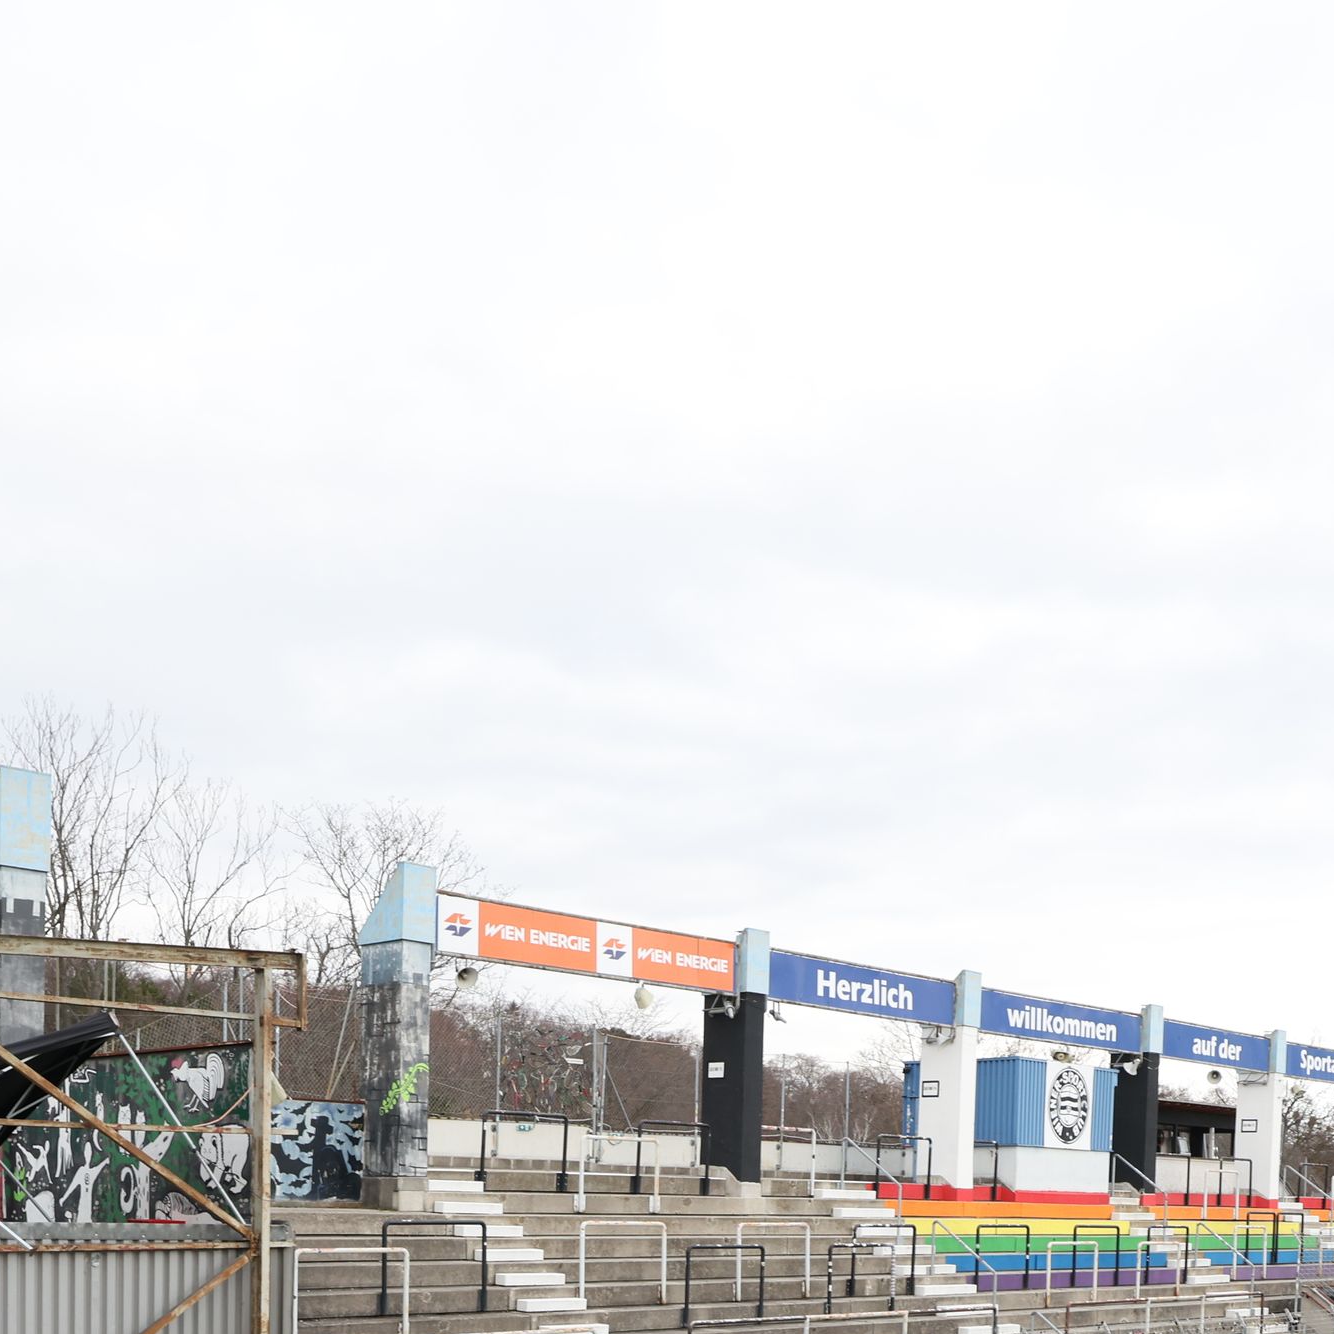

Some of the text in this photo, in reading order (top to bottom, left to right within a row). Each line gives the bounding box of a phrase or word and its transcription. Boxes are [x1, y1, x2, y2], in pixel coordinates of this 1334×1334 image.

[484, 922, 591, 952] WIEN ENERGIE
[637, 947, 729, 973] WIEN ENERGIE
[816, 969, 913, 1011] Herzlich
[1007, 1006, 1117, 1042] willkommen
[1192, 1036, 1242, 1062] auf der
